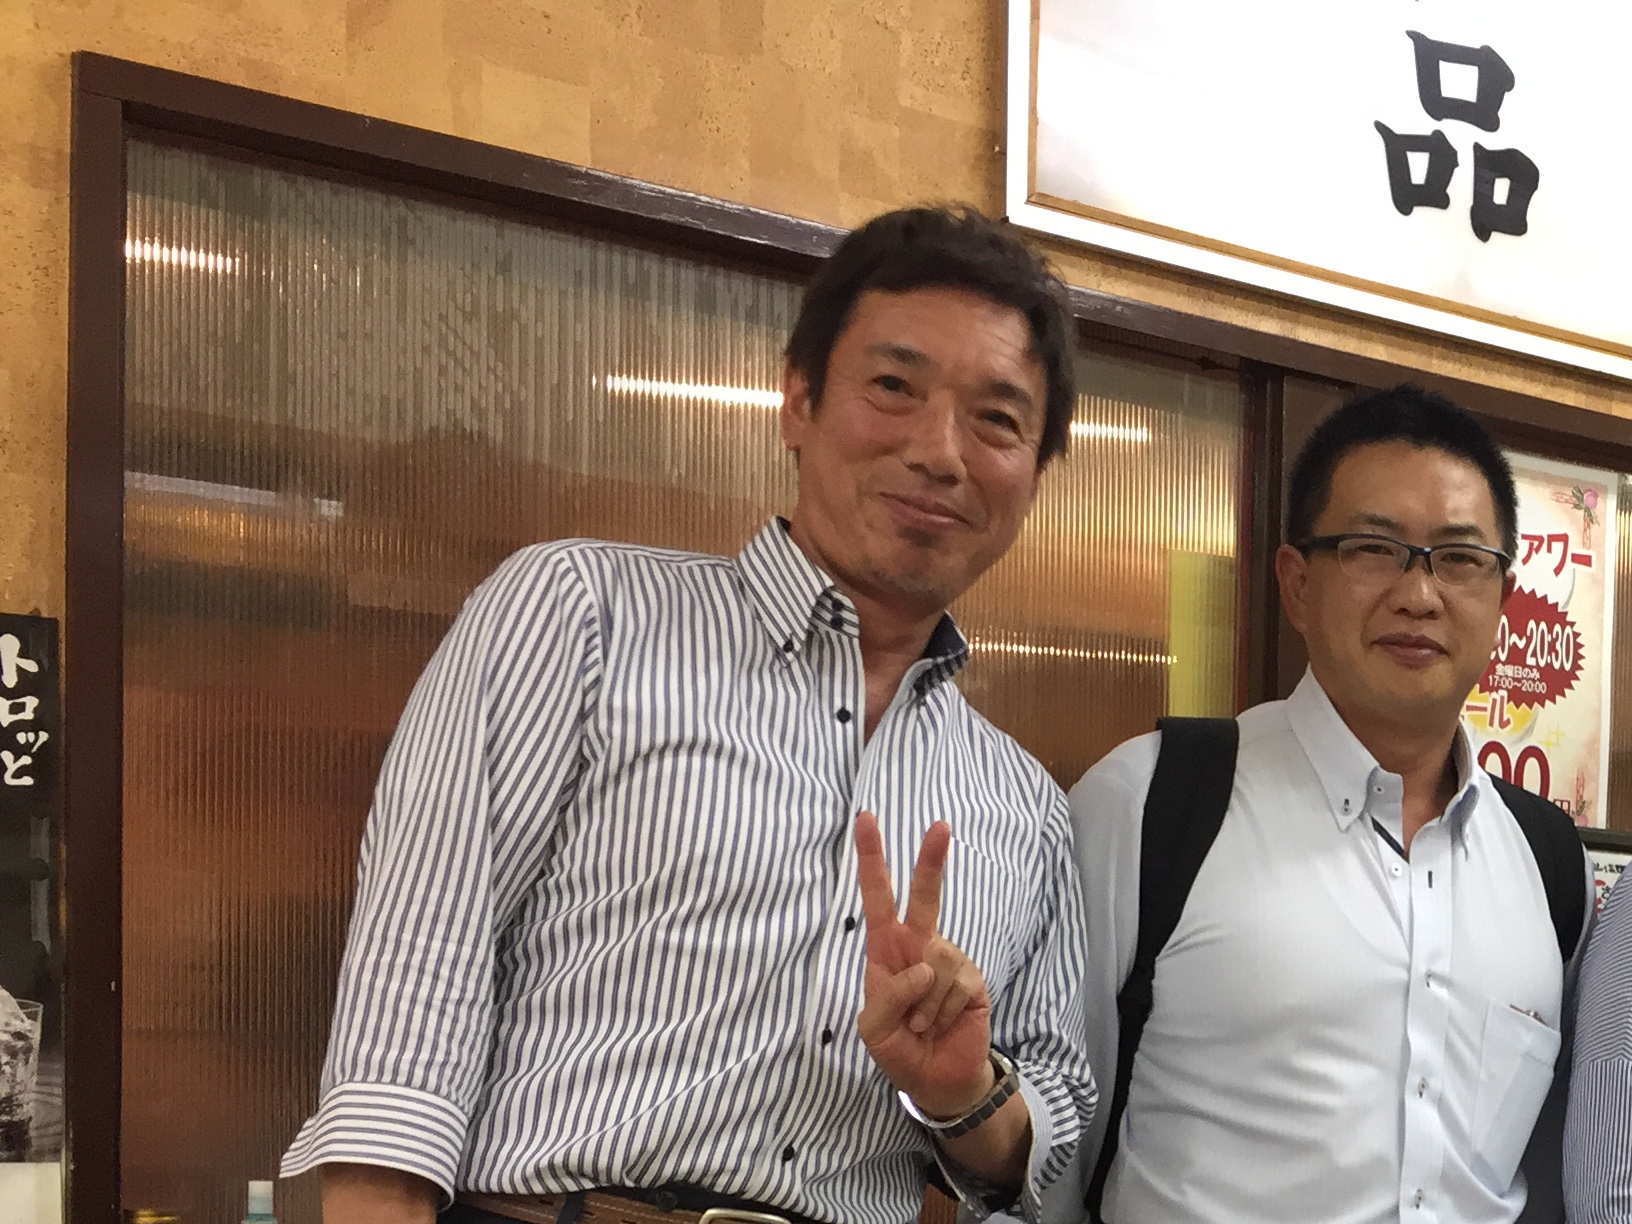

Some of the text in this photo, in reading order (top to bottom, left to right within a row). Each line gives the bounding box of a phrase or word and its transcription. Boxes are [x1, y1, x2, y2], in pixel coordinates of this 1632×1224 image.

[1517, 532, 1593, 577] アワー
[1491, 615, 1574, 672] 0~20:30
[1488, 675, 1547, 694] 17:00~20:00
[1495, 663, 1540, 680] 金曜日のみ
[1461, 691, 1511, 729] ール
